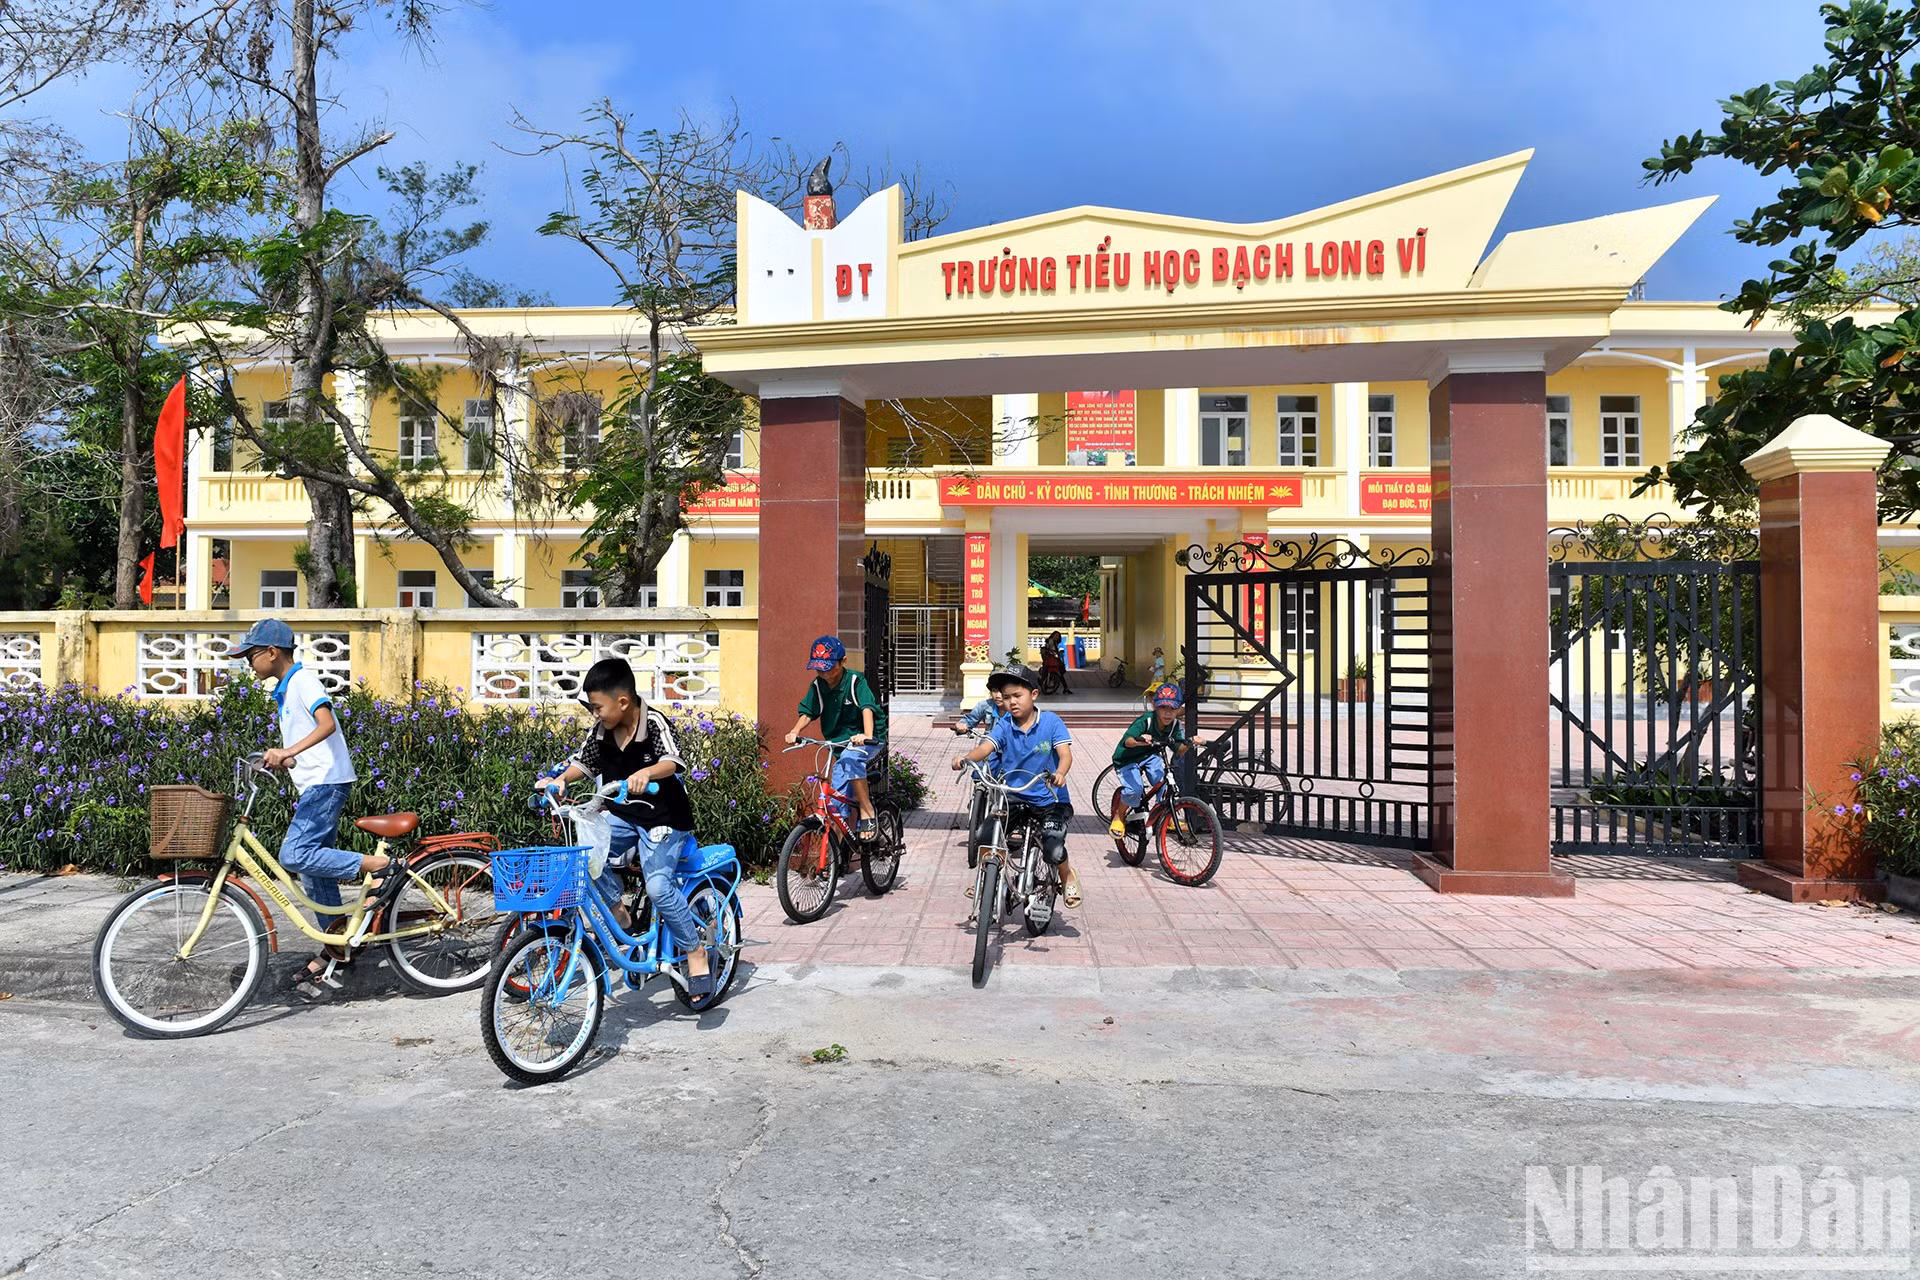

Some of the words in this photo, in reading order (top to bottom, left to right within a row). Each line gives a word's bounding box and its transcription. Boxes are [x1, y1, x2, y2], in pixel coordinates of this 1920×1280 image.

[941, 247, 1057, 295] TRƯỜNG
[1067, 235, 1130, 288] TIỂU
[1144, 249, 1200, 293] HỌC
[1213, 243, 1293, 290] BẠCH
[1305, 240, 1384, 276] LONG
[1397, 228, 1428, 272] VĨ
[977, 482, 1000, 499] DÂN
[1003, 480, 1026, 499] CHỦ
[1037, 481, 1051, 499] KỶ
[1054, 484, 1092, 500] CƯƠNG
[1104, 483, 1129, 500] TÌNH
[1132, 484, 1177, 500] THƯƠNG
[1188, 483, 1224, 500] TRÁCH
[1228, 483, 1265, 503] NHIỆM
[738, 496, 754, 507] NĂM
[967, 620, 987, 628] NGOAN
